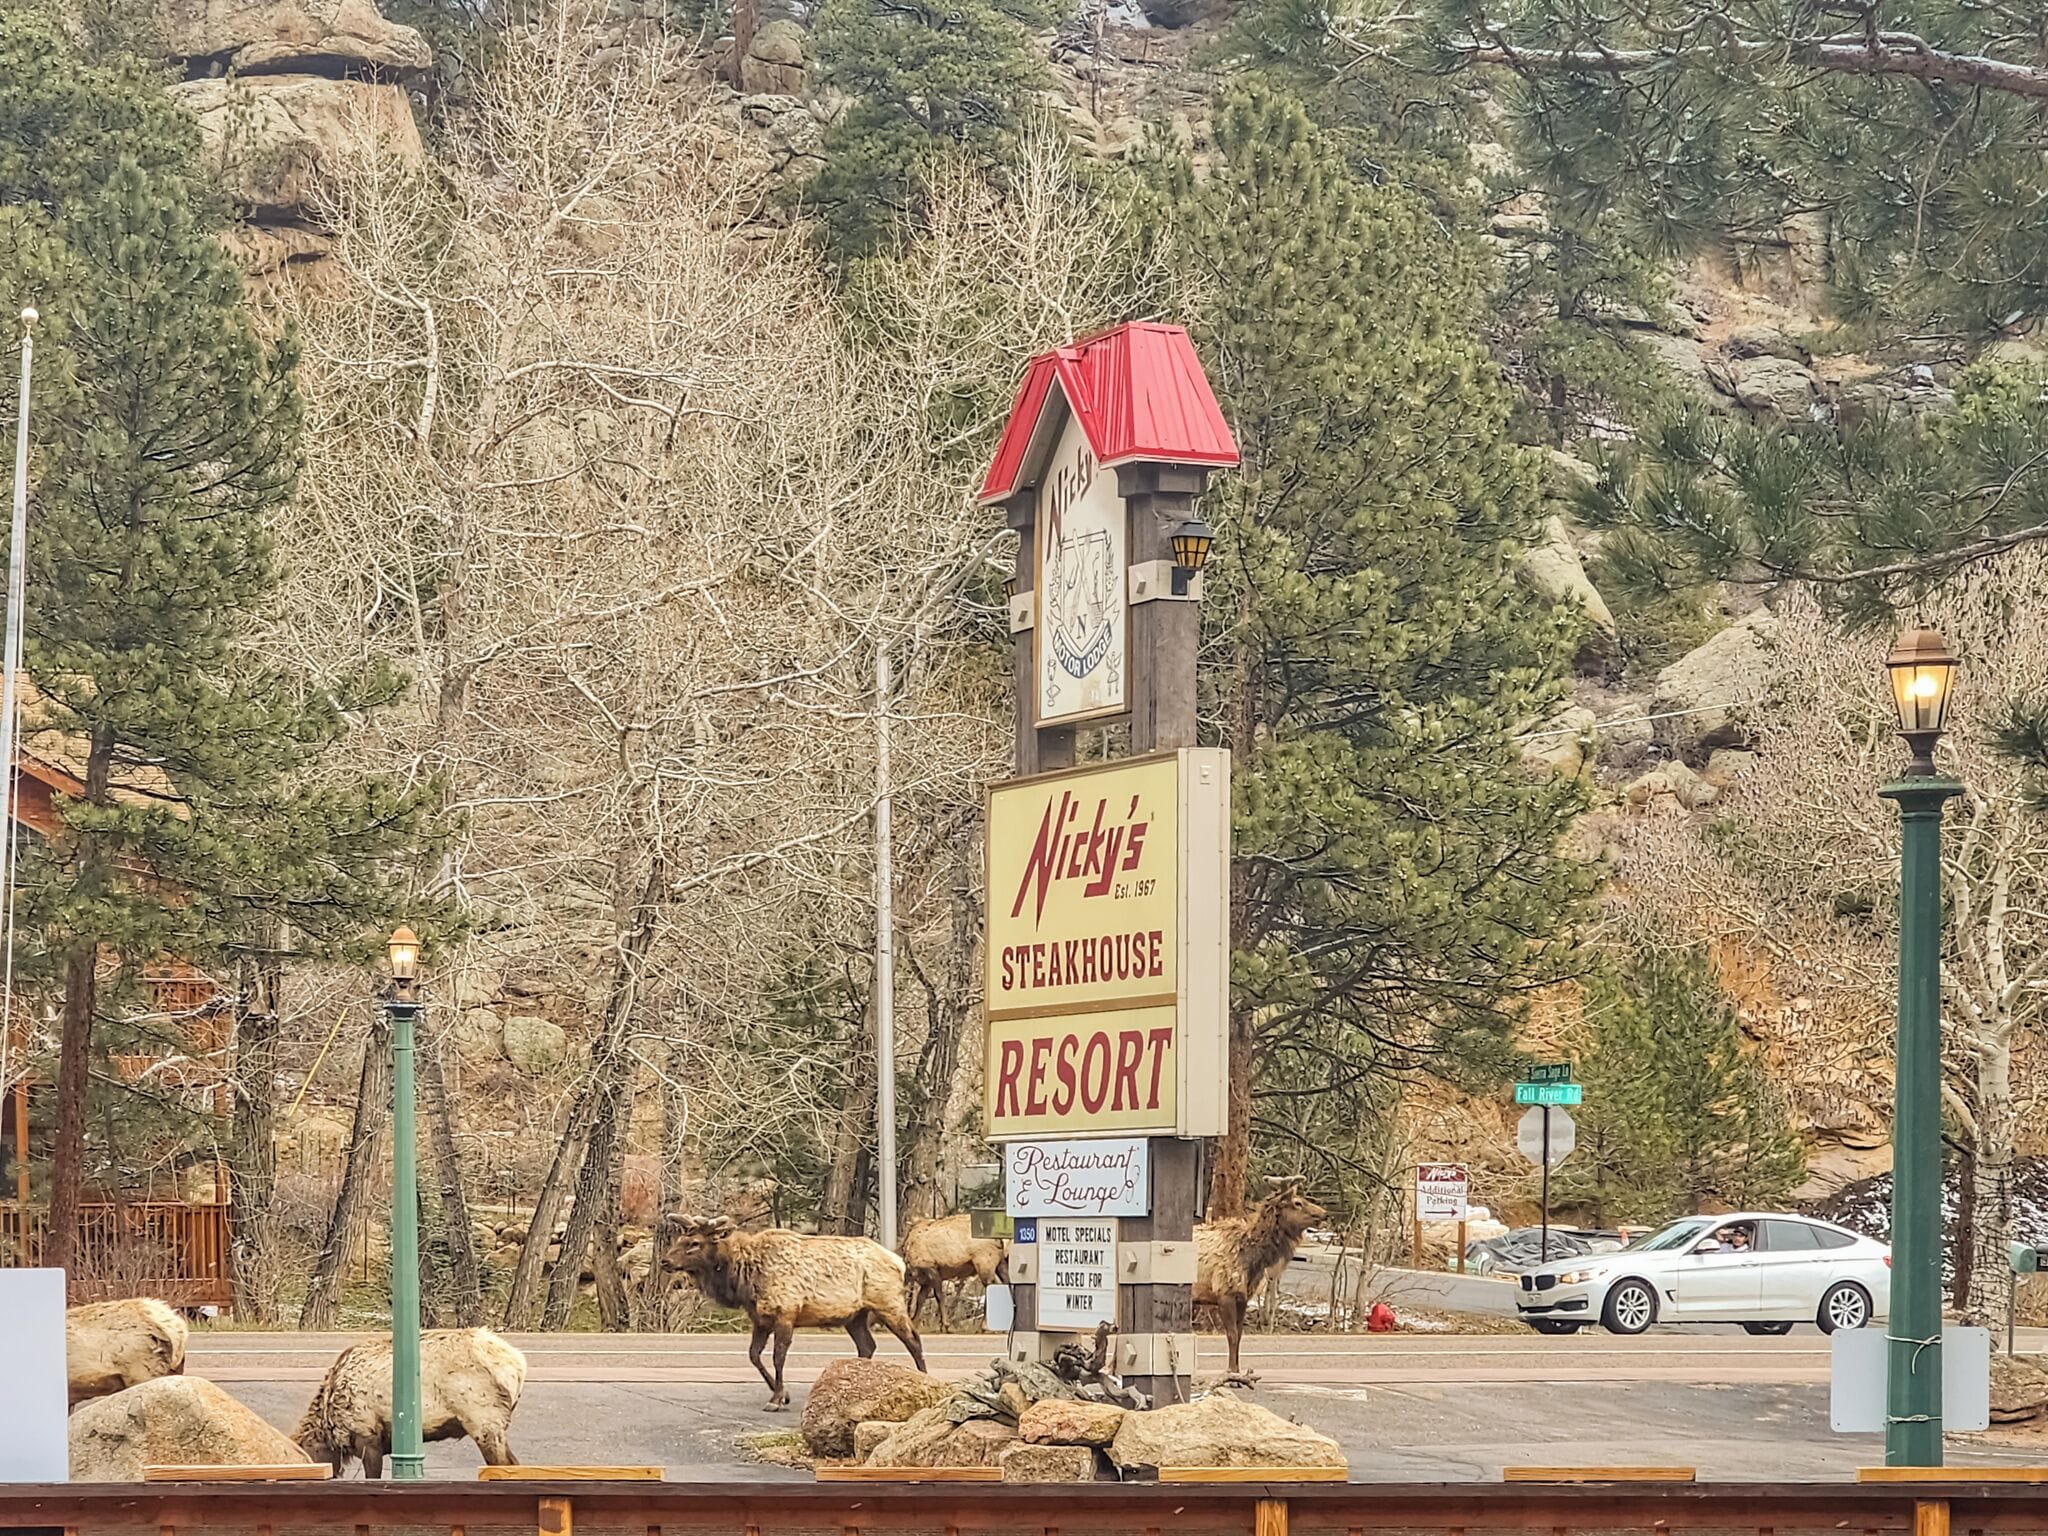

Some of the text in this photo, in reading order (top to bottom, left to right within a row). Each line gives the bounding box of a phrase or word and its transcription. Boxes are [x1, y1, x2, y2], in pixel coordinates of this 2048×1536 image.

[1076, 614, 1088, 639] N
[1054, 626, 1112, 677] MOTOR LODGE
[1011, 791, 1148, 932] Nicky's
[1114, 879, 1156, 900] Est. 1967
[1002, 930, 1163, 991] STEAKHOUSE
[994, 1027, 1173, 1118] RESORT
[1517, 1087, 1579, 1101] Fall River Rd
[1013, 1145, 1137, 1190] Restaurant
[1043, 1173, 1124, 1213] Lounge
[1422, 1185, 1464, 1195] Additional
[1426, 1196, 1458, 1207] Parking
[1019, 1227, 1035, 1241] 1350
[1045, 1226, 1112, 1243] MOTEL SPECIALS
[1055, 1249, 1105, 1265] RESTAURANT
[1056, 1272, 1103, 1288] CLOSED FOR
[1066, 1294, 1094, 1310] WINTER
